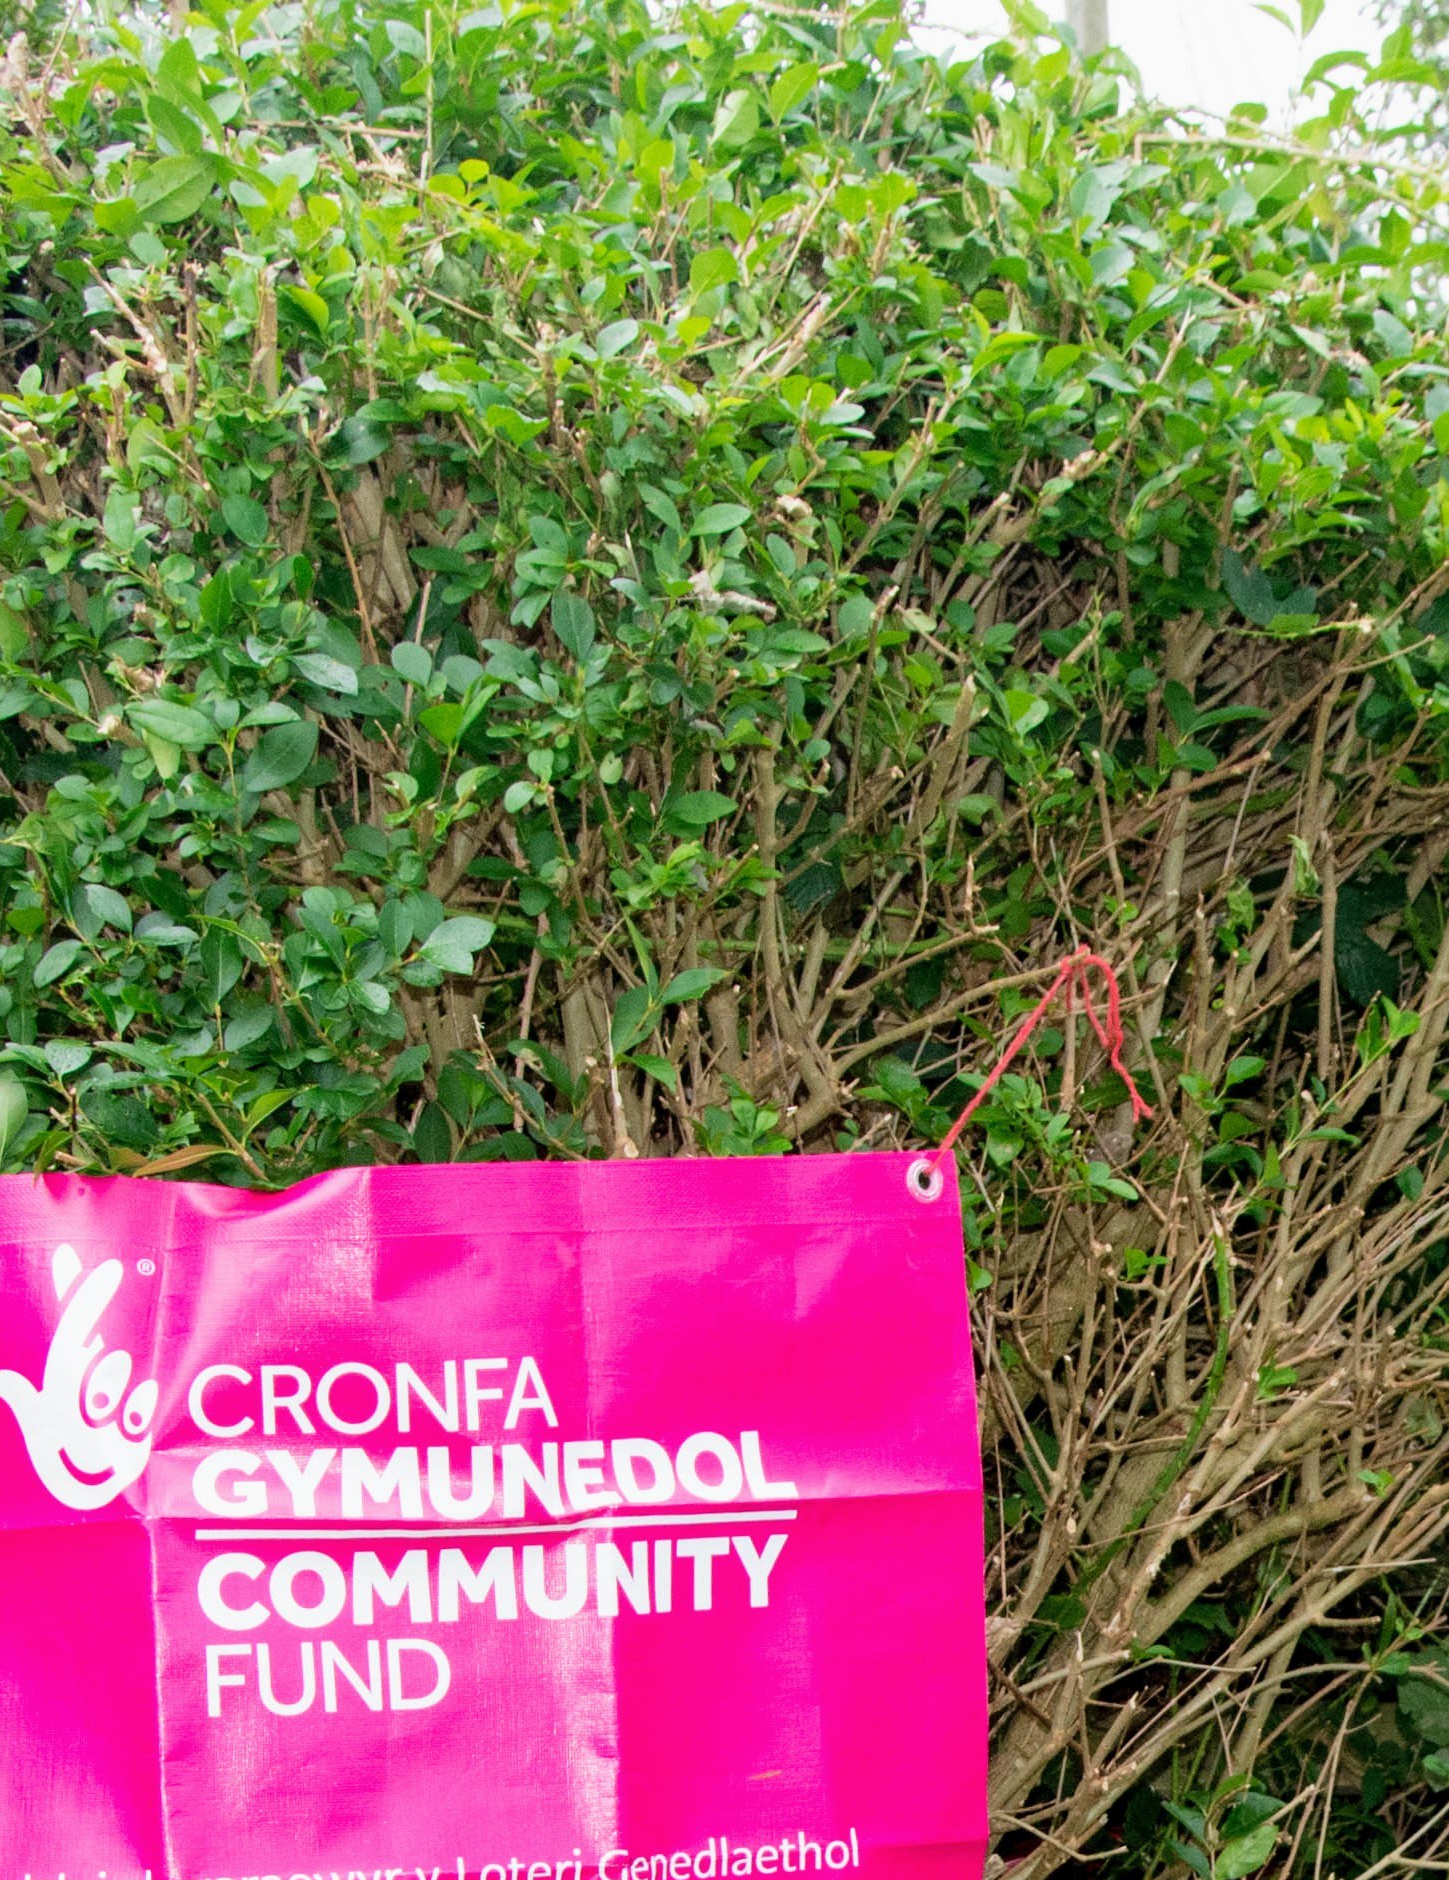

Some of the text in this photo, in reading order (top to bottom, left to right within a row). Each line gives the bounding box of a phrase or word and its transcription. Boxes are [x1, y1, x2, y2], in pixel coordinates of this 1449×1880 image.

[188, 1356, 558, 1438] CRONFA
[192, 1430, 798, 1520] GYMUNEDOL
[197, 1534, 789, 1631] COMMUNITY
[206, 1638, 451, 1717] FUND
